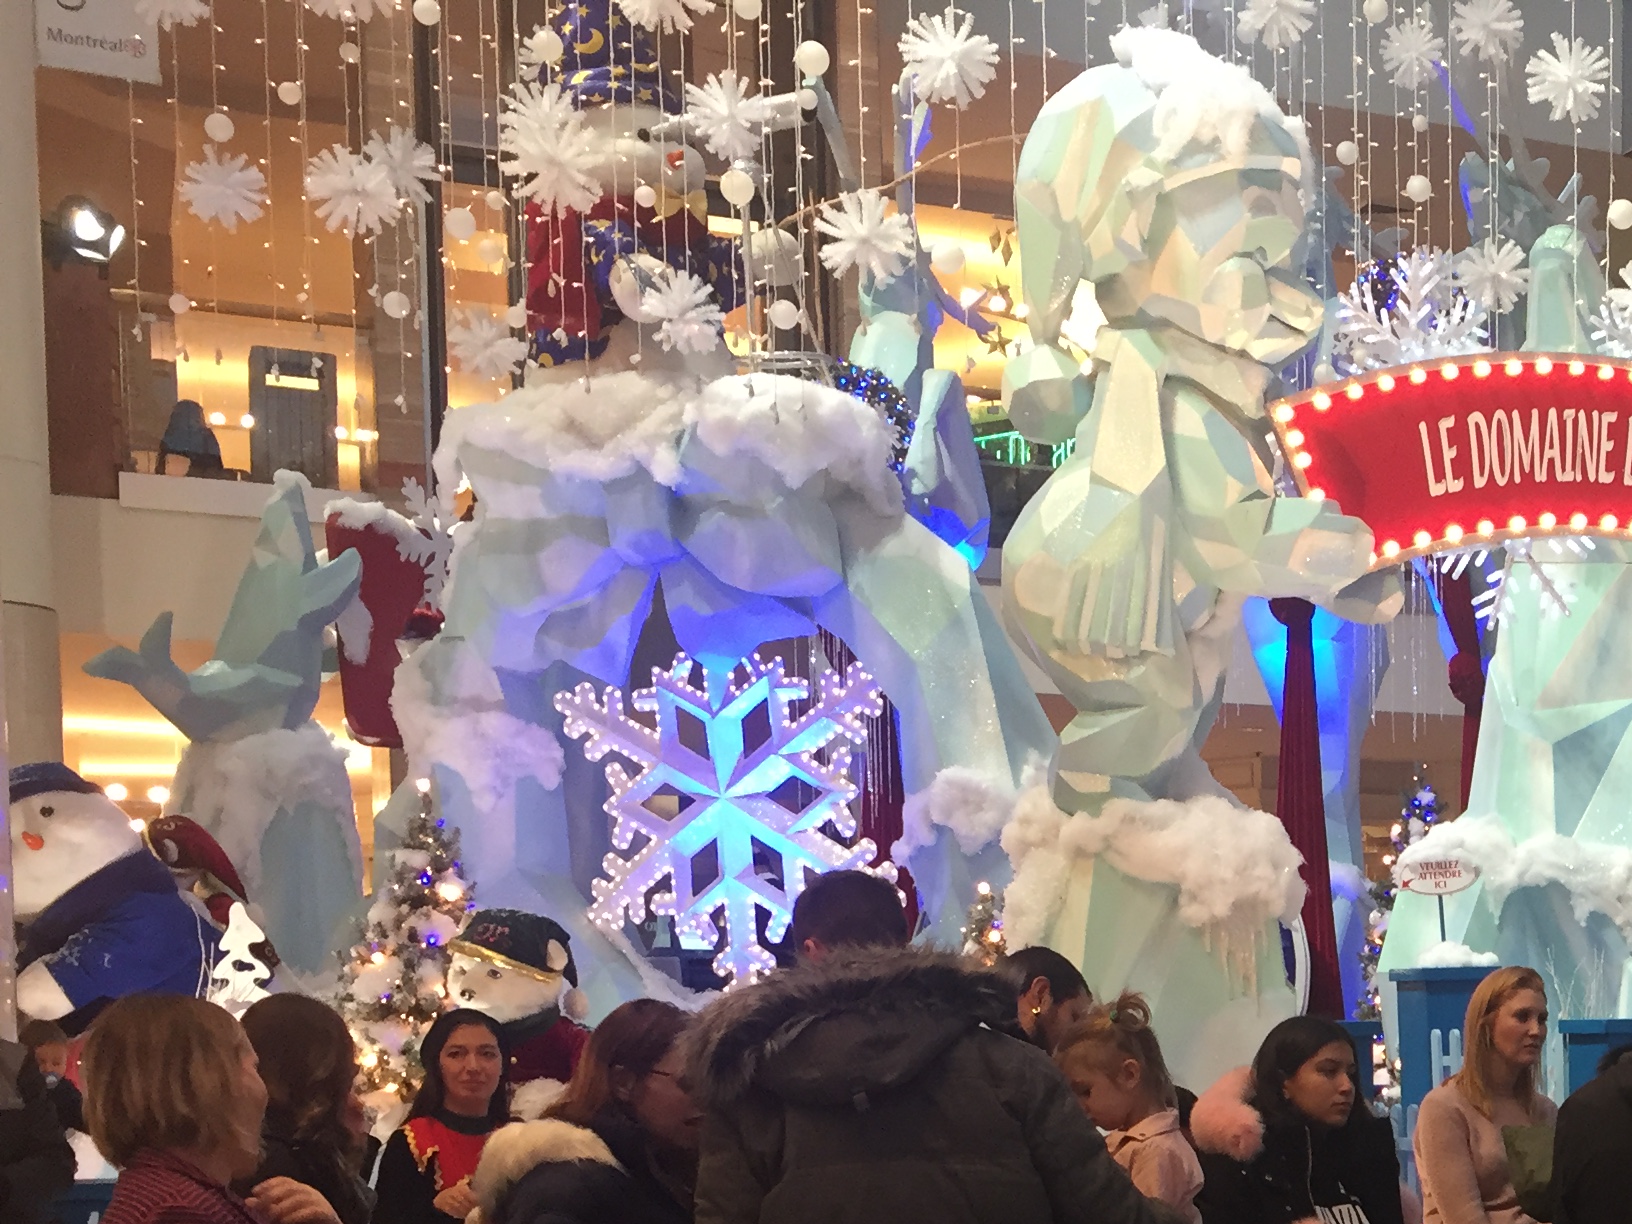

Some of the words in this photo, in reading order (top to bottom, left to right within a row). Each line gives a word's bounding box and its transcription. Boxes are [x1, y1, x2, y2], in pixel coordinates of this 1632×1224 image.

[1419, 415, 1464, 497] LE
[1467, 407, 1618, 488] DOMAINE
[1418, 869, 1462, 880] ATTENDRE
[1434, 880, 1447, 889] ICI
